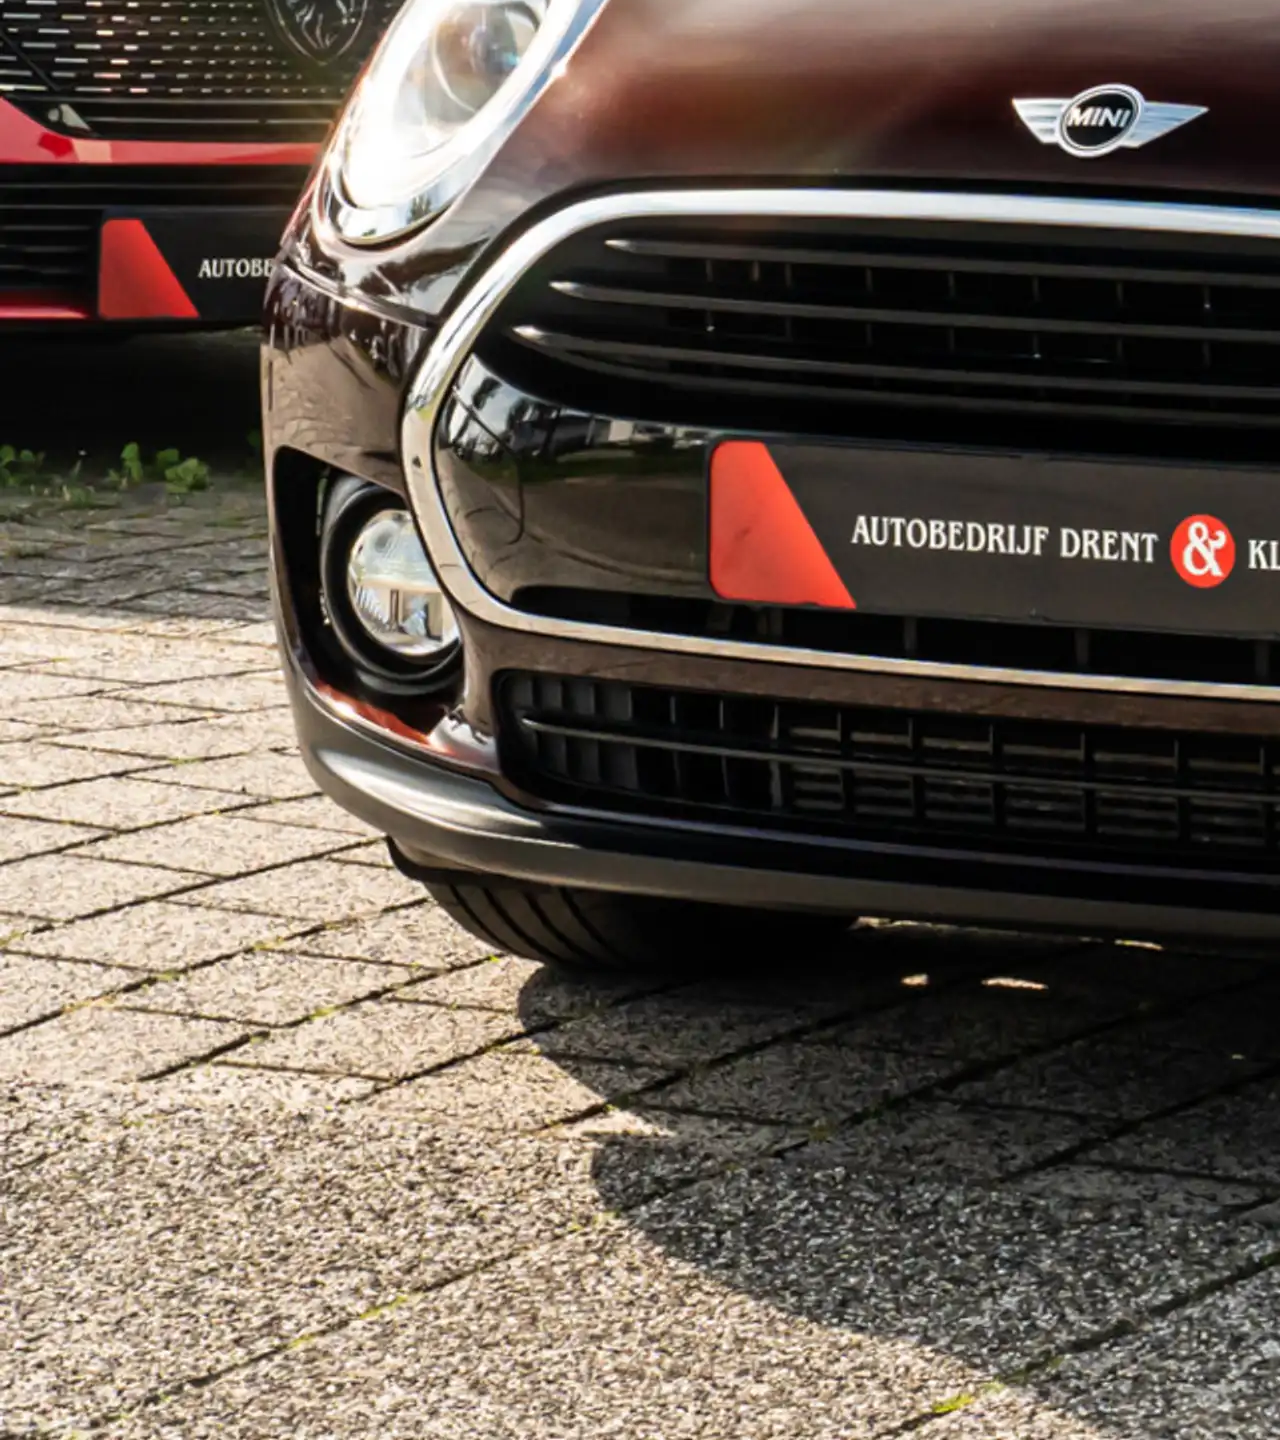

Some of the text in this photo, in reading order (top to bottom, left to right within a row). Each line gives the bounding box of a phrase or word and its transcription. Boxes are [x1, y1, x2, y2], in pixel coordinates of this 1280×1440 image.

[1066, 105, 1133, 128] MINI
[851, 514, 1050, 557] AUTOBEDRIJF
[1059, 526, 1160, 564] DRENT
[1182, 520, 1228, 577] &
